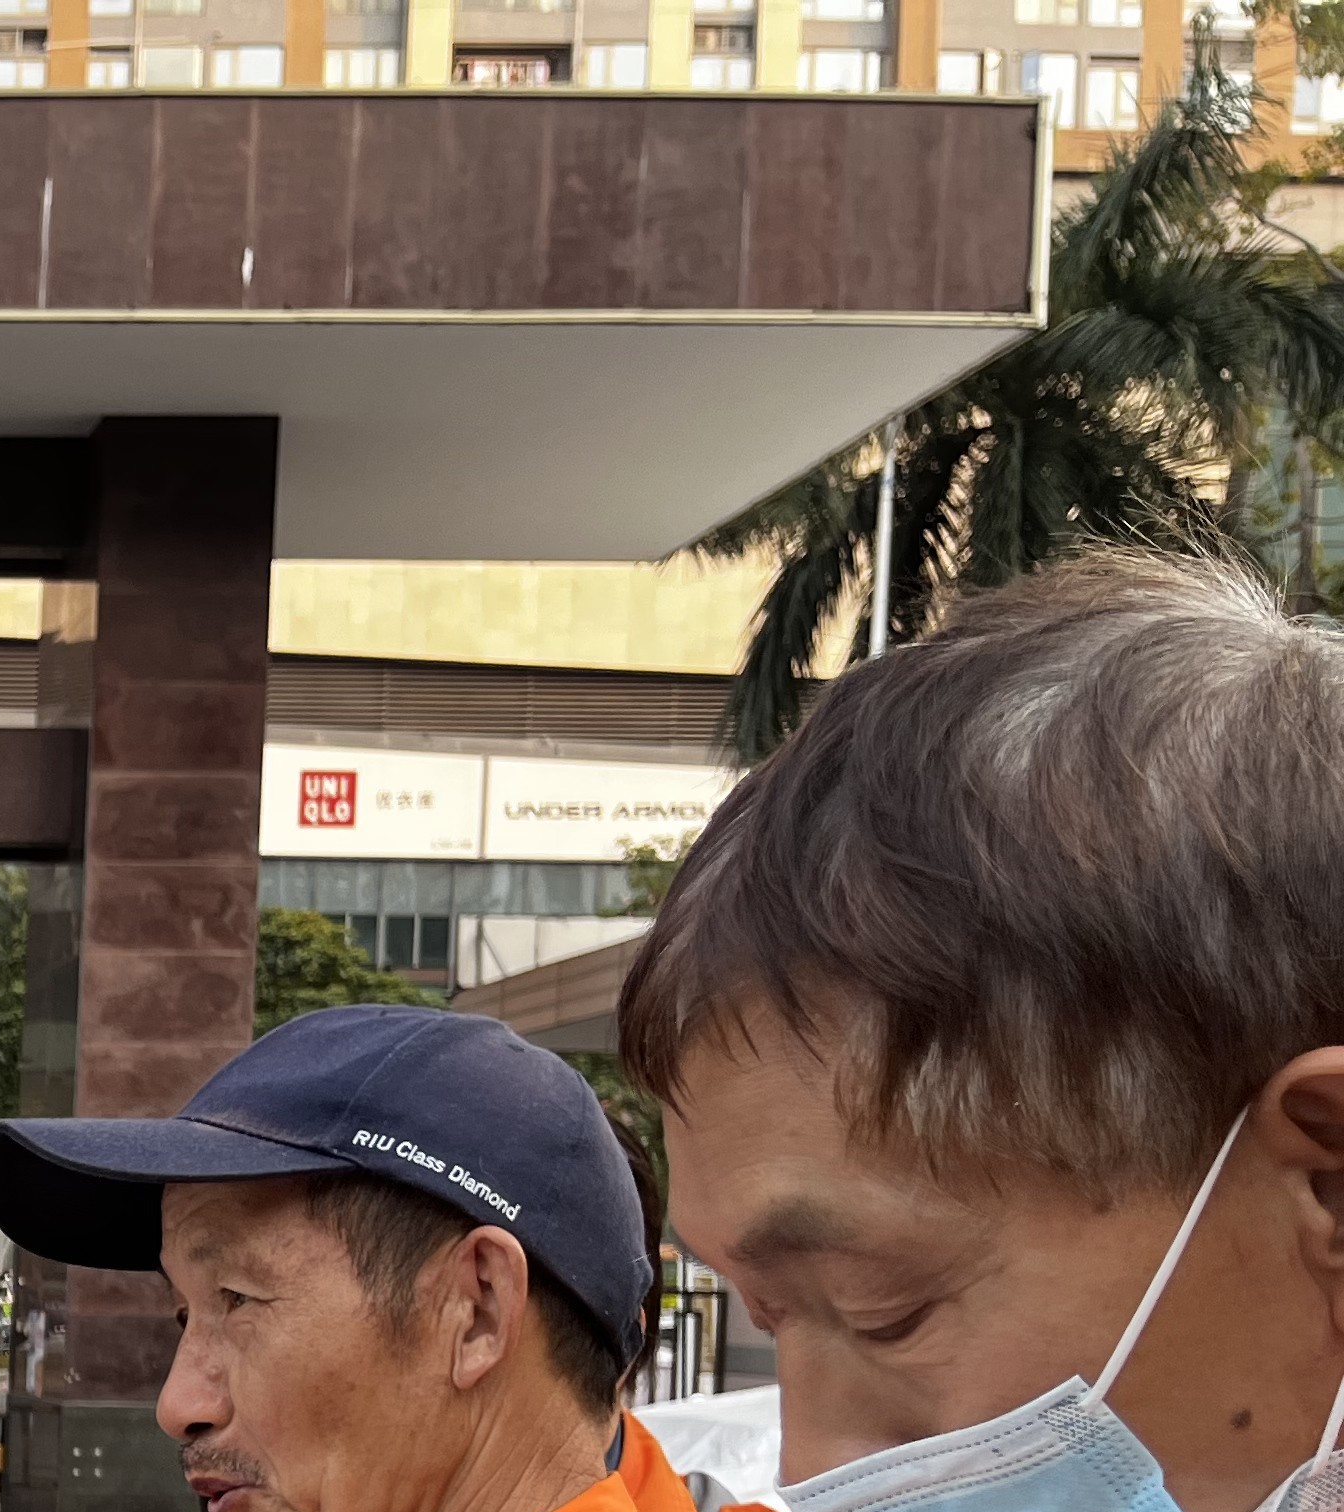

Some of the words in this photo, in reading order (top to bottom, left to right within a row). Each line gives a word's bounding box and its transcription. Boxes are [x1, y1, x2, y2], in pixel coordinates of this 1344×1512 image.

[304, 775, 350, 798] UNI
[303, 799, 352, 823] QLO
[504, 801, 603, 821] UNDER
[352, 1129, 395, 1152] RIU
[396, 1141, 447, 1173] Class
[447, 1165, 522, 1222] Diamond
